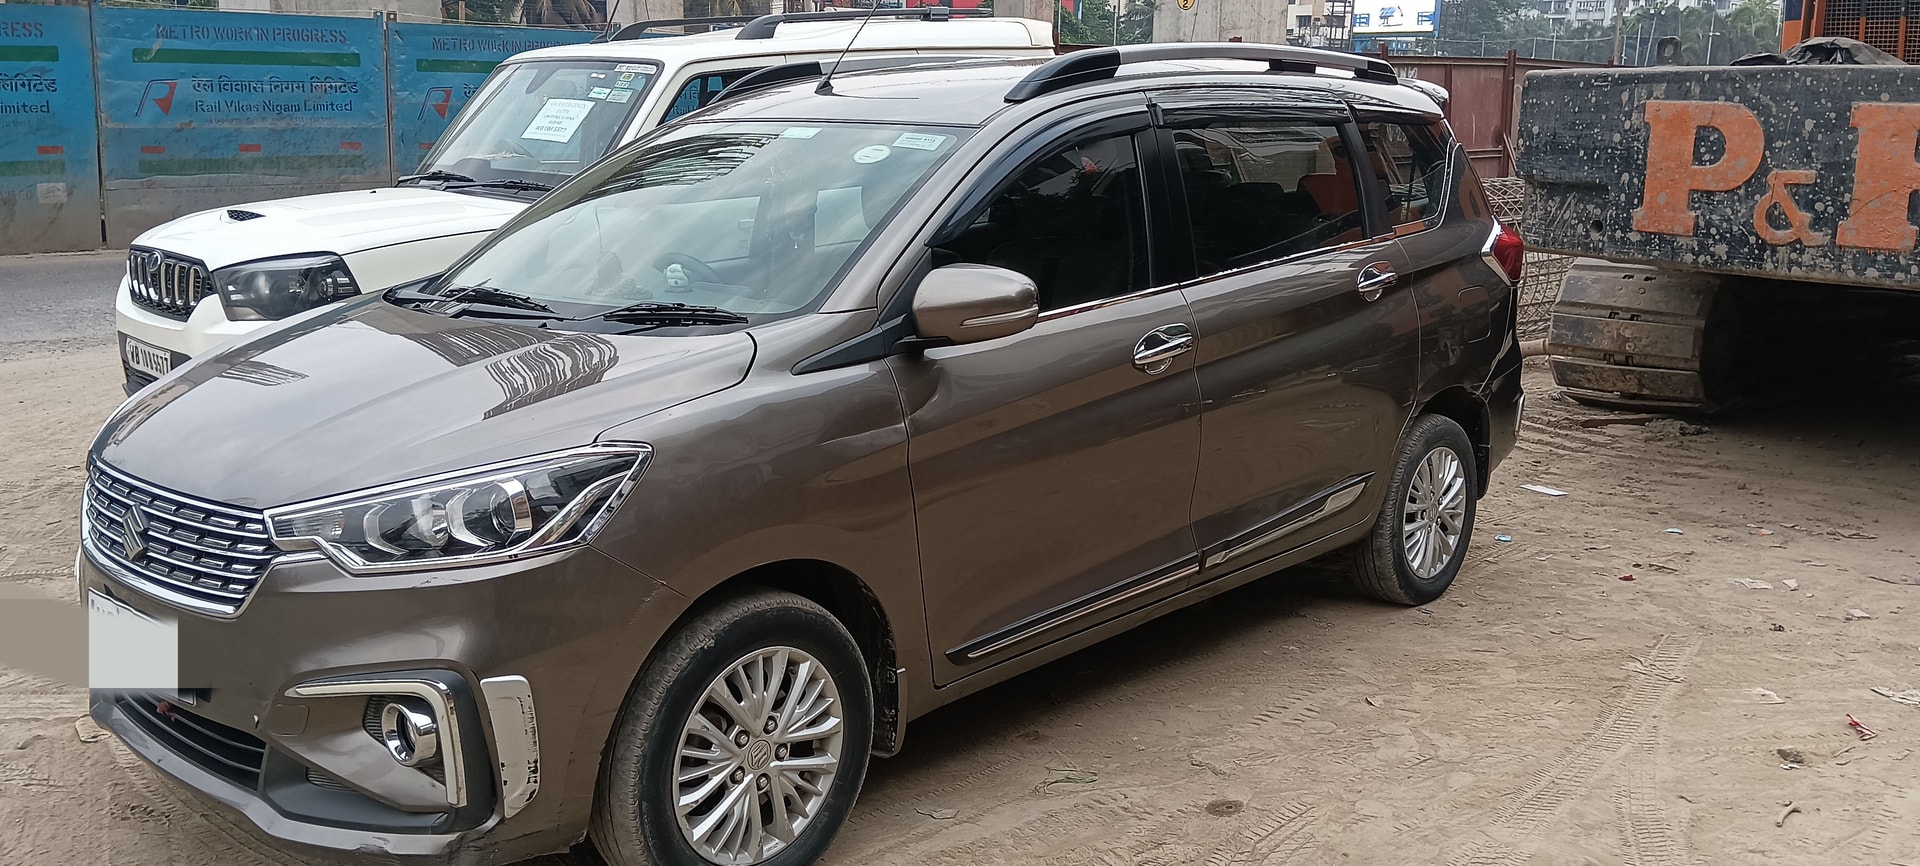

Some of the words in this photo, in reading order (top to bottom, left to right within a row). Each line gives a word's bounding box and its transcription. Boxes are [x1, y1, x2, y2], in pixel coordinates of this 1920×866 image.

[156, 24, 210, 40] METRO
[214, 25, 250, 41] WORK
[256, 26, 269, 42] IN
[273, 28, 348, 44] PROGRESS
[432, 37, 475, 51] METRO
[478, 39, 509, 52] WORK
[512, 40, 522, 53] IN
[218, 75, 264, 93] विकास
[310, 75, 359, 94] लिमिटेड
[0, 100, 50, 114] imited
[195, 99, 221, 112] Rail
[224, 99, 260, 112] Vikas
[262, 100, 300, 115] Nigam
[304, 99, 353, 112] Limited
